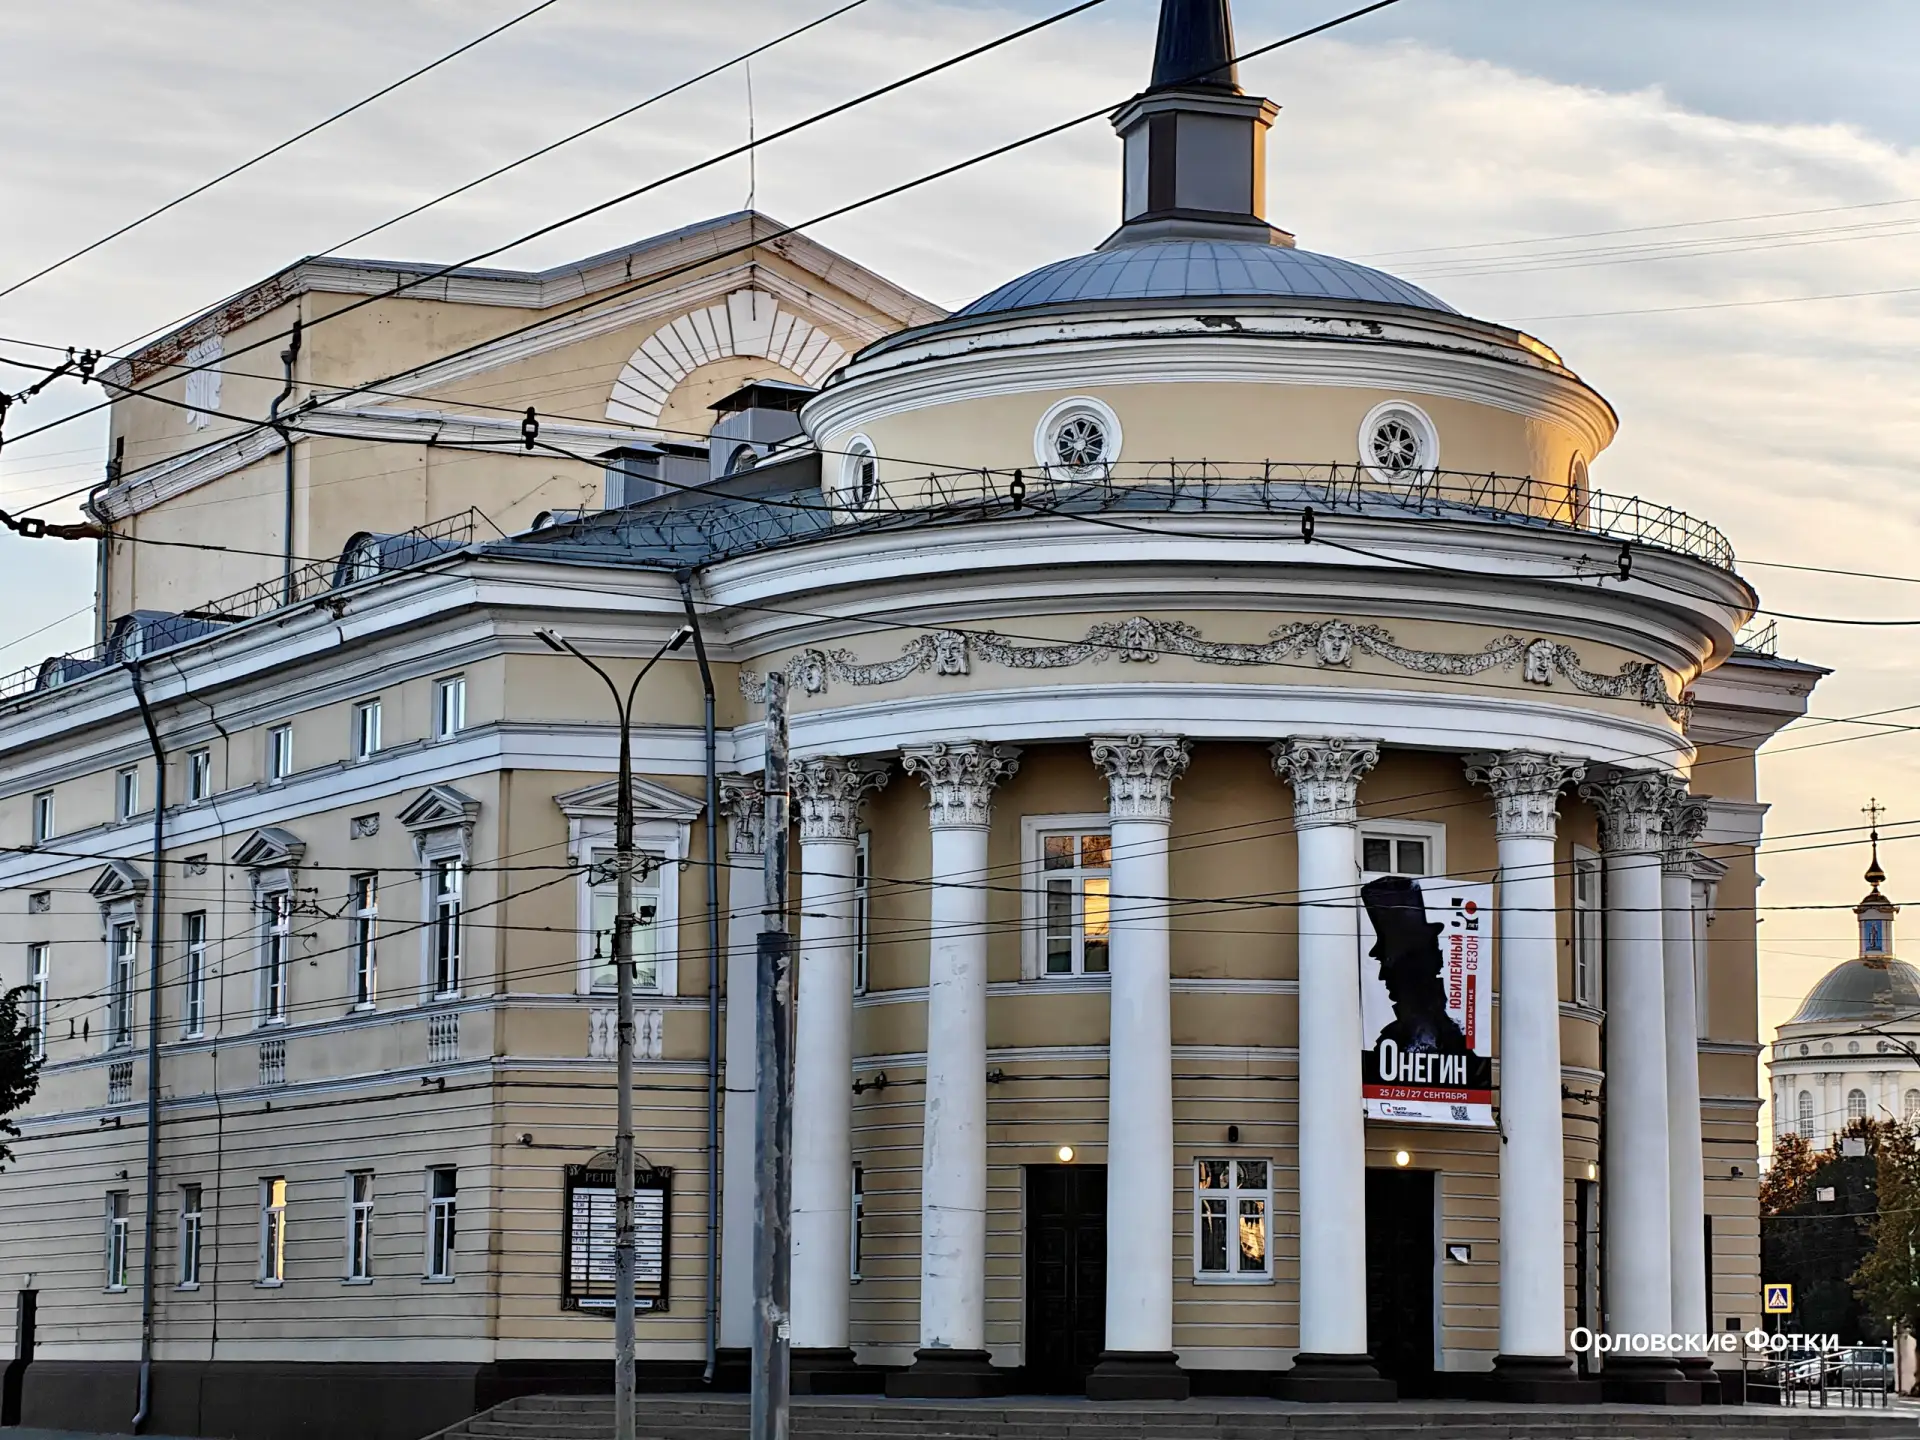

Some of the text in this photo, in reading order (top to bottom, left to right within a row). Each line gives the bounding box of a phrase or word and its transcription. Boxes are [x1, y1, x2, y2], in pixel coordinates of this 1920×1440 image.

[1466, 935, 1479, 970] СЕЗОН
[1448, 934, 1463, 1009] ЮБИЛЕЙНЫЙ
[1423, 1090, 1467, 1100] СЕНТЯБРЯ
